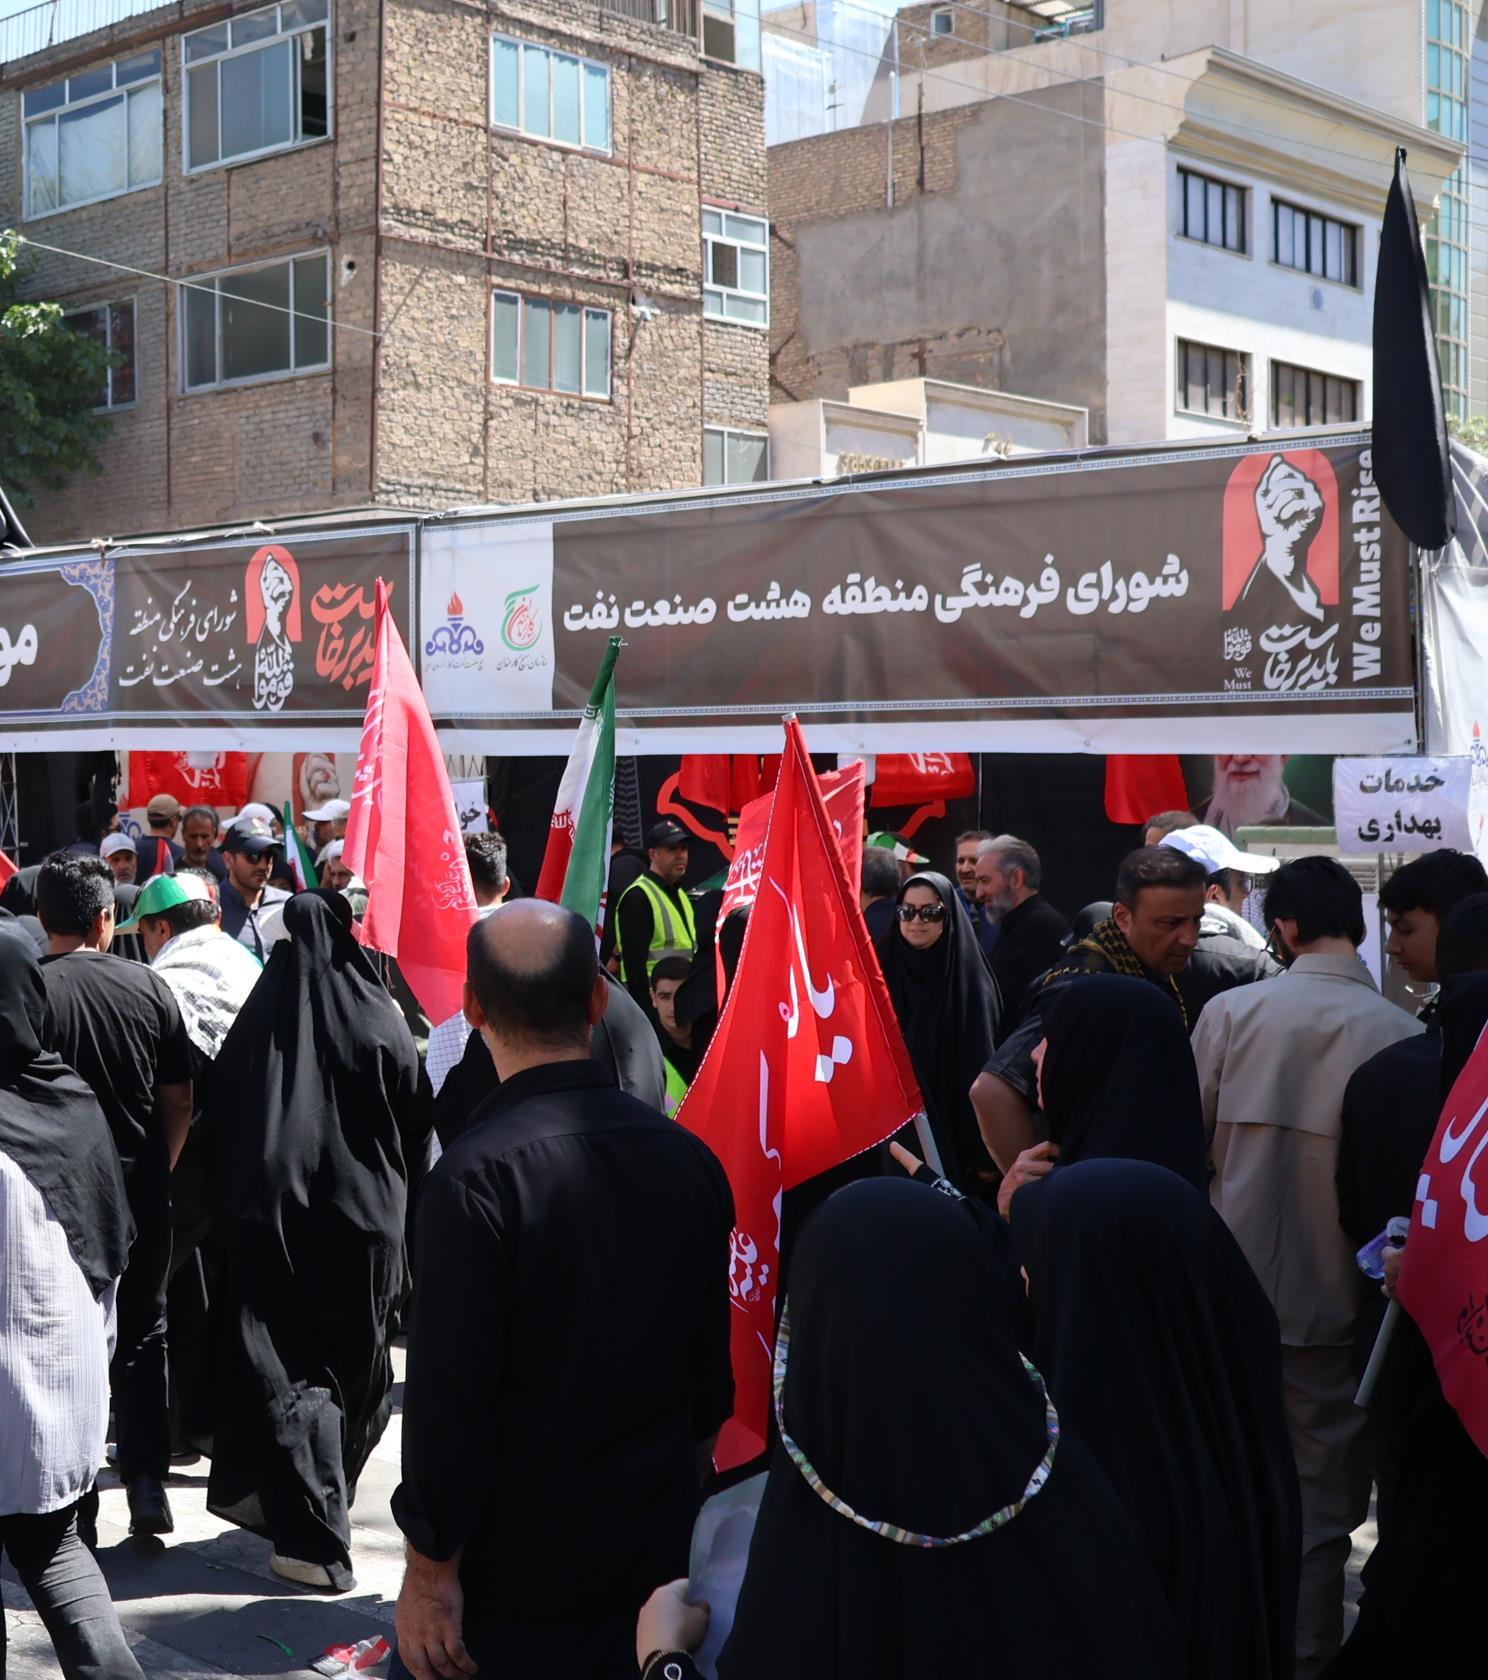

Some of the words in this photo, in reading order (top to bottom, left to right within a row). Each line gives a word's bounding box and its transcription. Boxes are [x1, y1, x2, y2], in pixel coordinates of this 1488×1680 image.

[1351, 449, 1381, 524] Rise
[933, 552, 1060, 624] فرهنگی
[1065, 553, 1190, 616] شورای
[1352, 527, 1381, 617] Must
[157, 579, 197, 642] فرهنگی
[195, 587, 239, 641] شورای
[563, 590, 620, 632] نفت
[623, 592, 717, 628] صنعت
[727, 580, 811, 622] هشت
[821, 572, 928, 617] منطقه
[128, 596, 161, 636] منطقه
[118, 645, 156, 687] نفت
[152, 651, 203, 687] صنعت
[202, 648, 243, 690] هشت
[1233, 667, 1253, 678] We
[1352, 622, 1381, 681] We
[1223, 679, 1253, 690] Must
[1358, 767, 1446, 796] خدمات
[1357, 810, 1442, 844] بهداری
